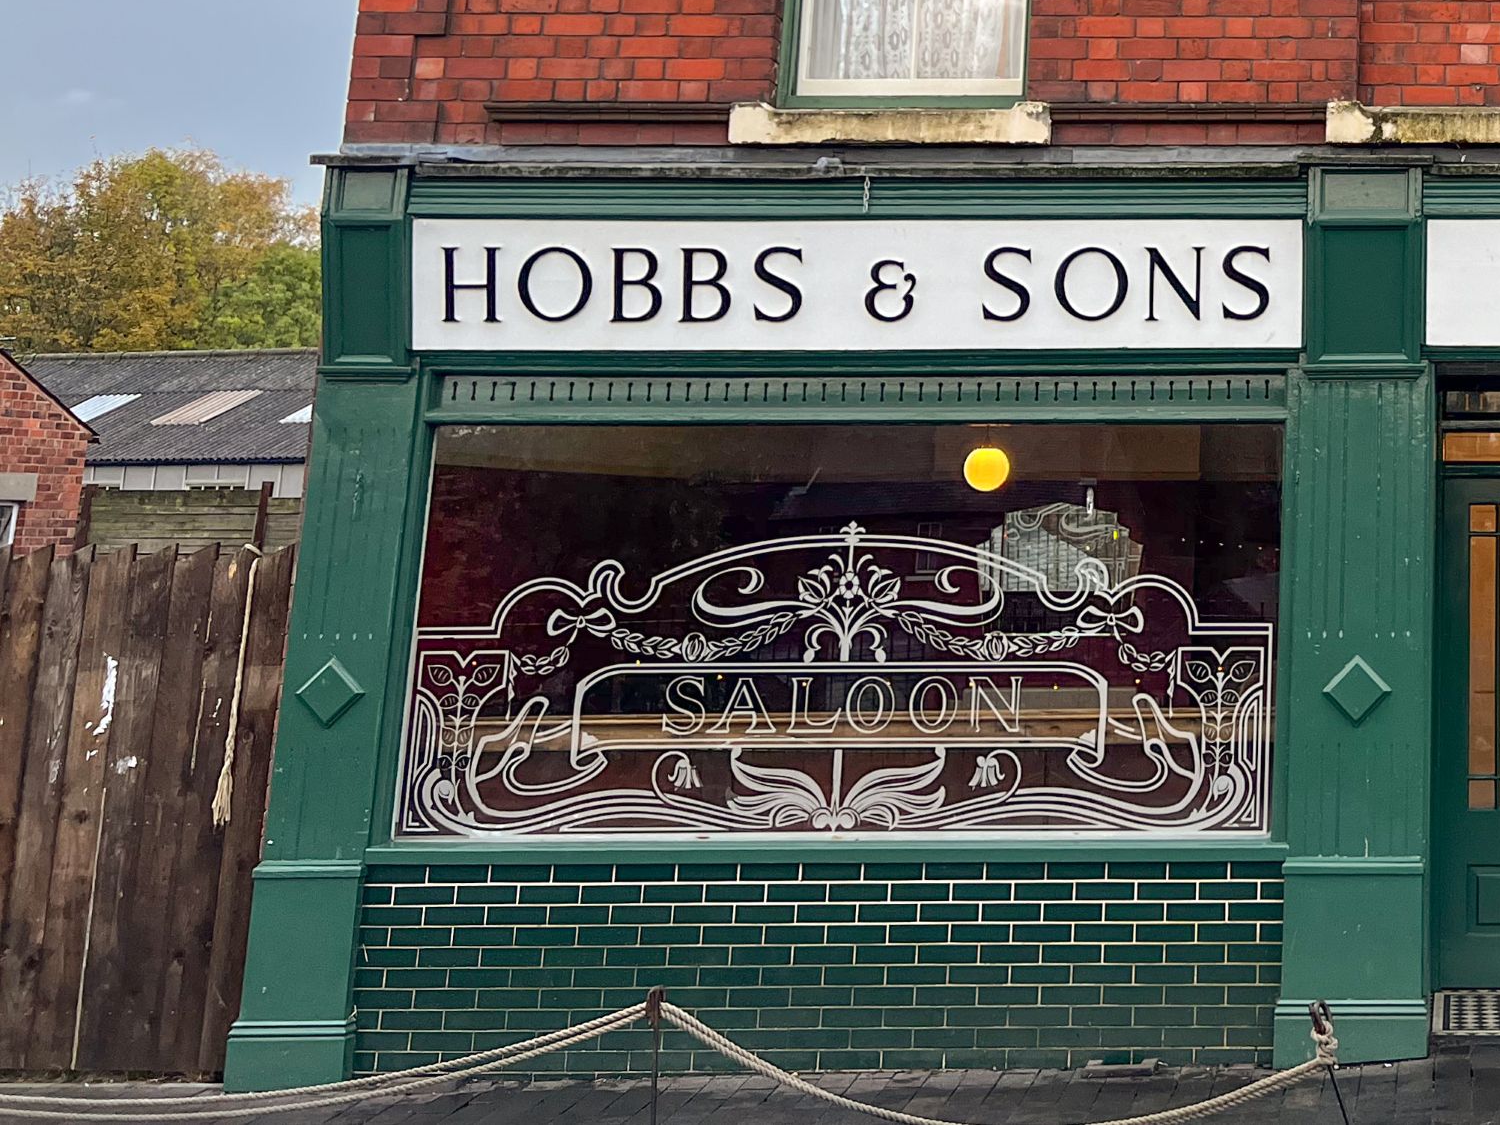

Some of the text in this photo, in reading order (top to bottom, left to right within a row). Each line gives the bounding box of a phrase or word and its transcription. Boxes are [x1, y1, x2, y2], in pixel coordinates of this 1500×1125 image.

[441, 245, 1270, 324] HOBBS & SONS
[661, 675, 1022, 736] SALOON
